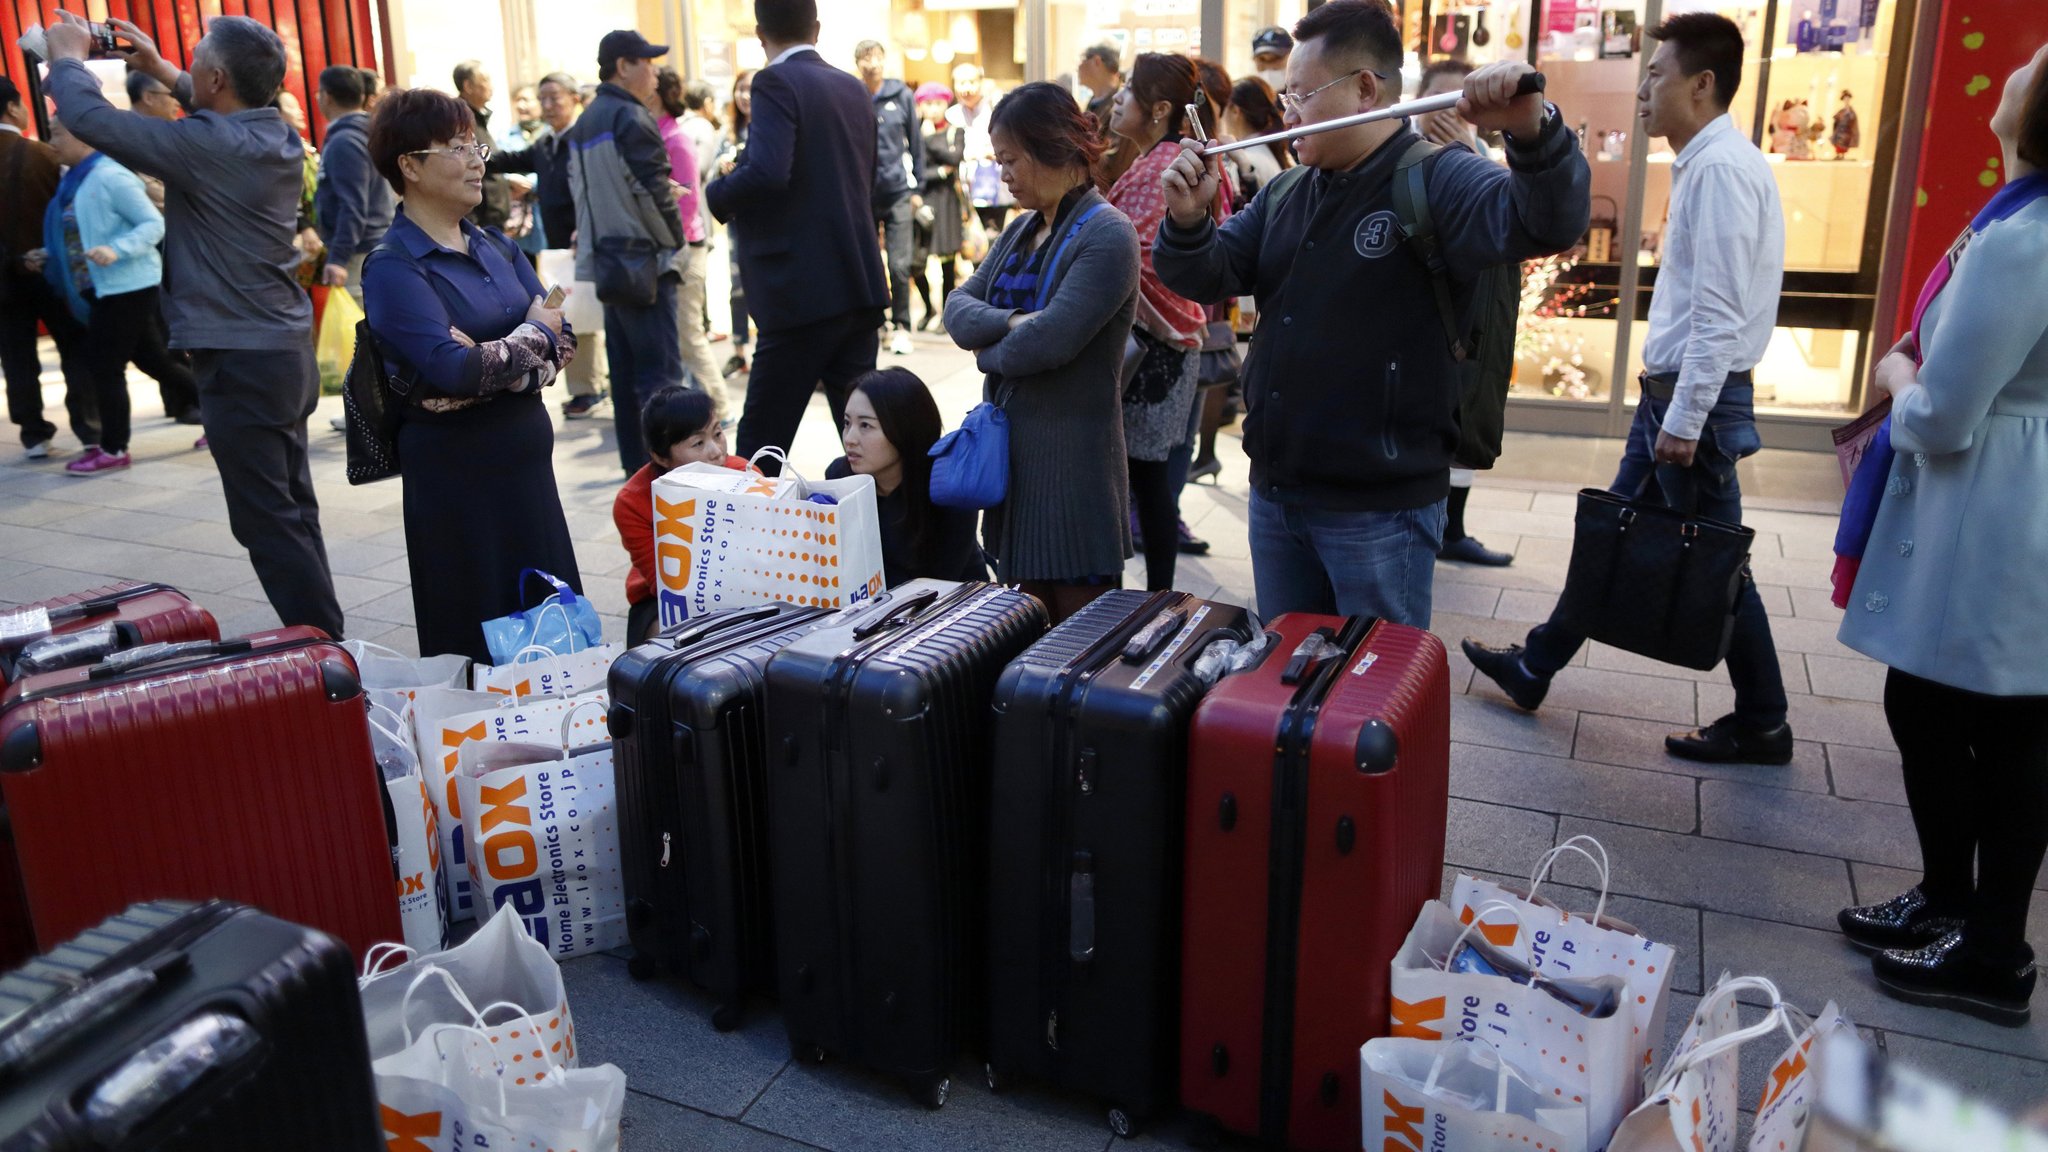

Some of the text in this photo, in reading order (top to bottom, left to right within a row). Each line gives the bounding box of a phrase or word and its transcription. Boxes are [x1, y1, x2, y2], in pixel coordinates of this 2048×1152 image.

[694, 500, 717, 612] ctronics Store
[537, 772, 574, 954] Home Electronics Store
[1456, 995, 1480, 1042] tore
